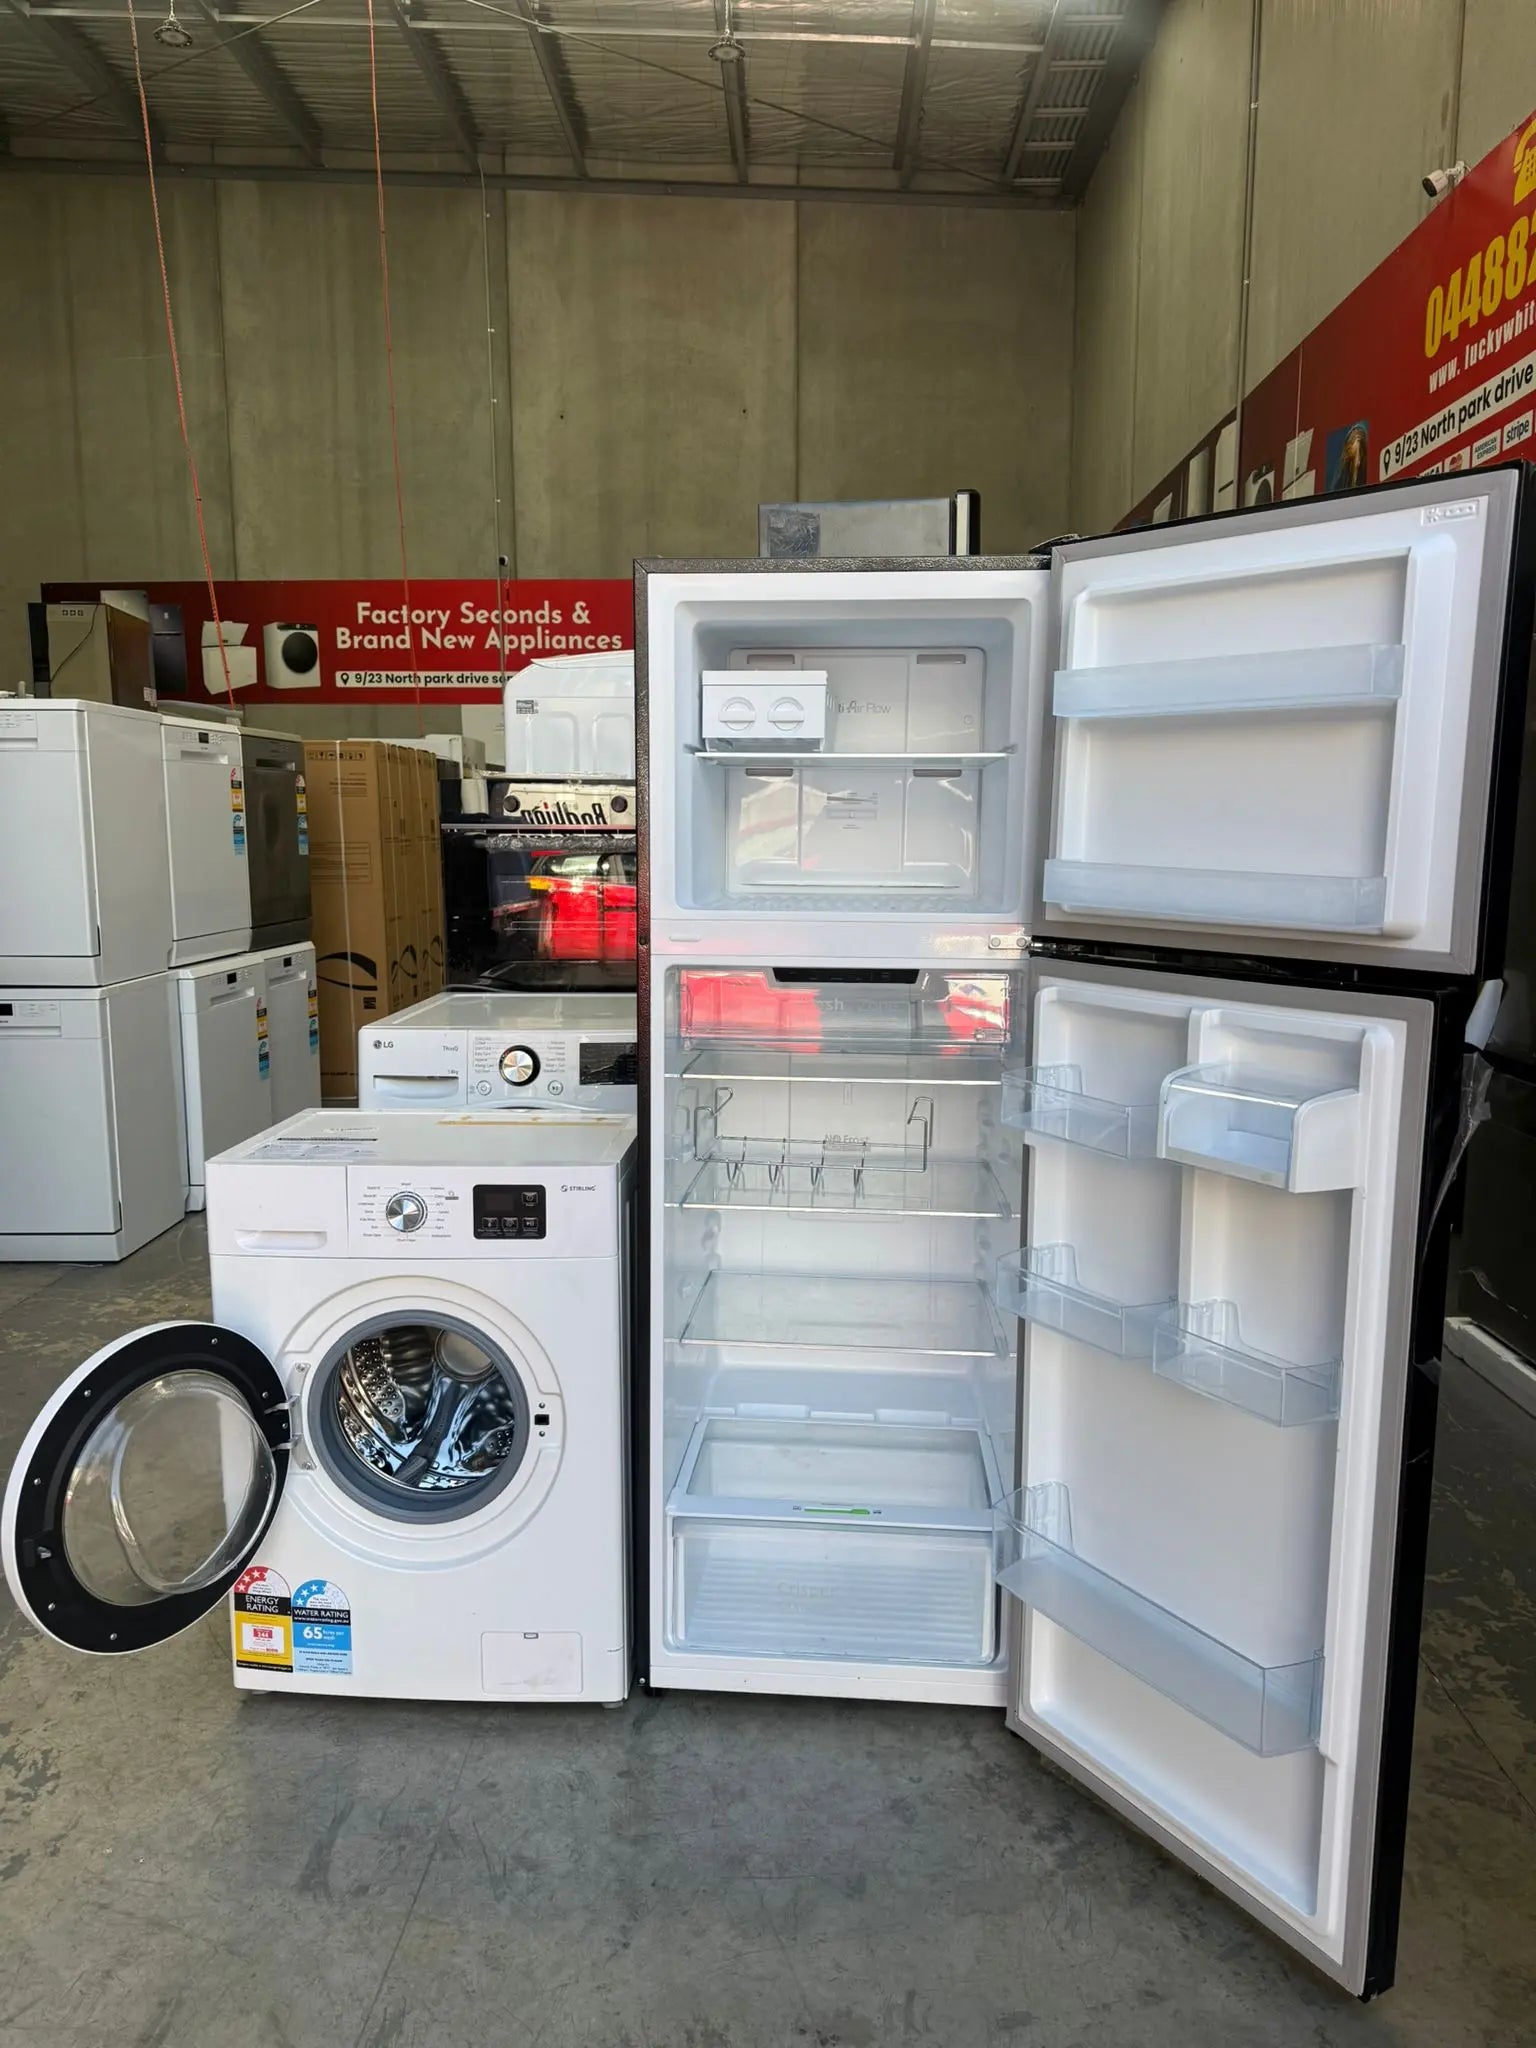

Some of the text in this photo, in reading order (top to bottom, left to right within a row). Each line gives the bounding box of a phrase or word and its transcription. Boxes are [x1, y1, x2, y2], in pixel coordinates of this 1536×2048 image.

[1429, 300, 1536, 394] www. luckywhit
[1394, 363, 1533, 466] 9/23 North park drive
[1505, 418, 1530, 444] stripe
[357, 600, 591, 629] Factory Seconds &
[336, 626, 623, 655] Brand New Appliances
[354, 673, 383, 685] 9/23
[386, 673, 421, 684] North
[424, 673, 452, 687] park
[457, 673, 489, 684] drive
[245, 1595, 279, 1605] ENERGY
[246, 1603, 279, 1613] RATING
[293, 1609, 349, 1619] WATER RATING
[303, 1626, 323, 1639] 65
